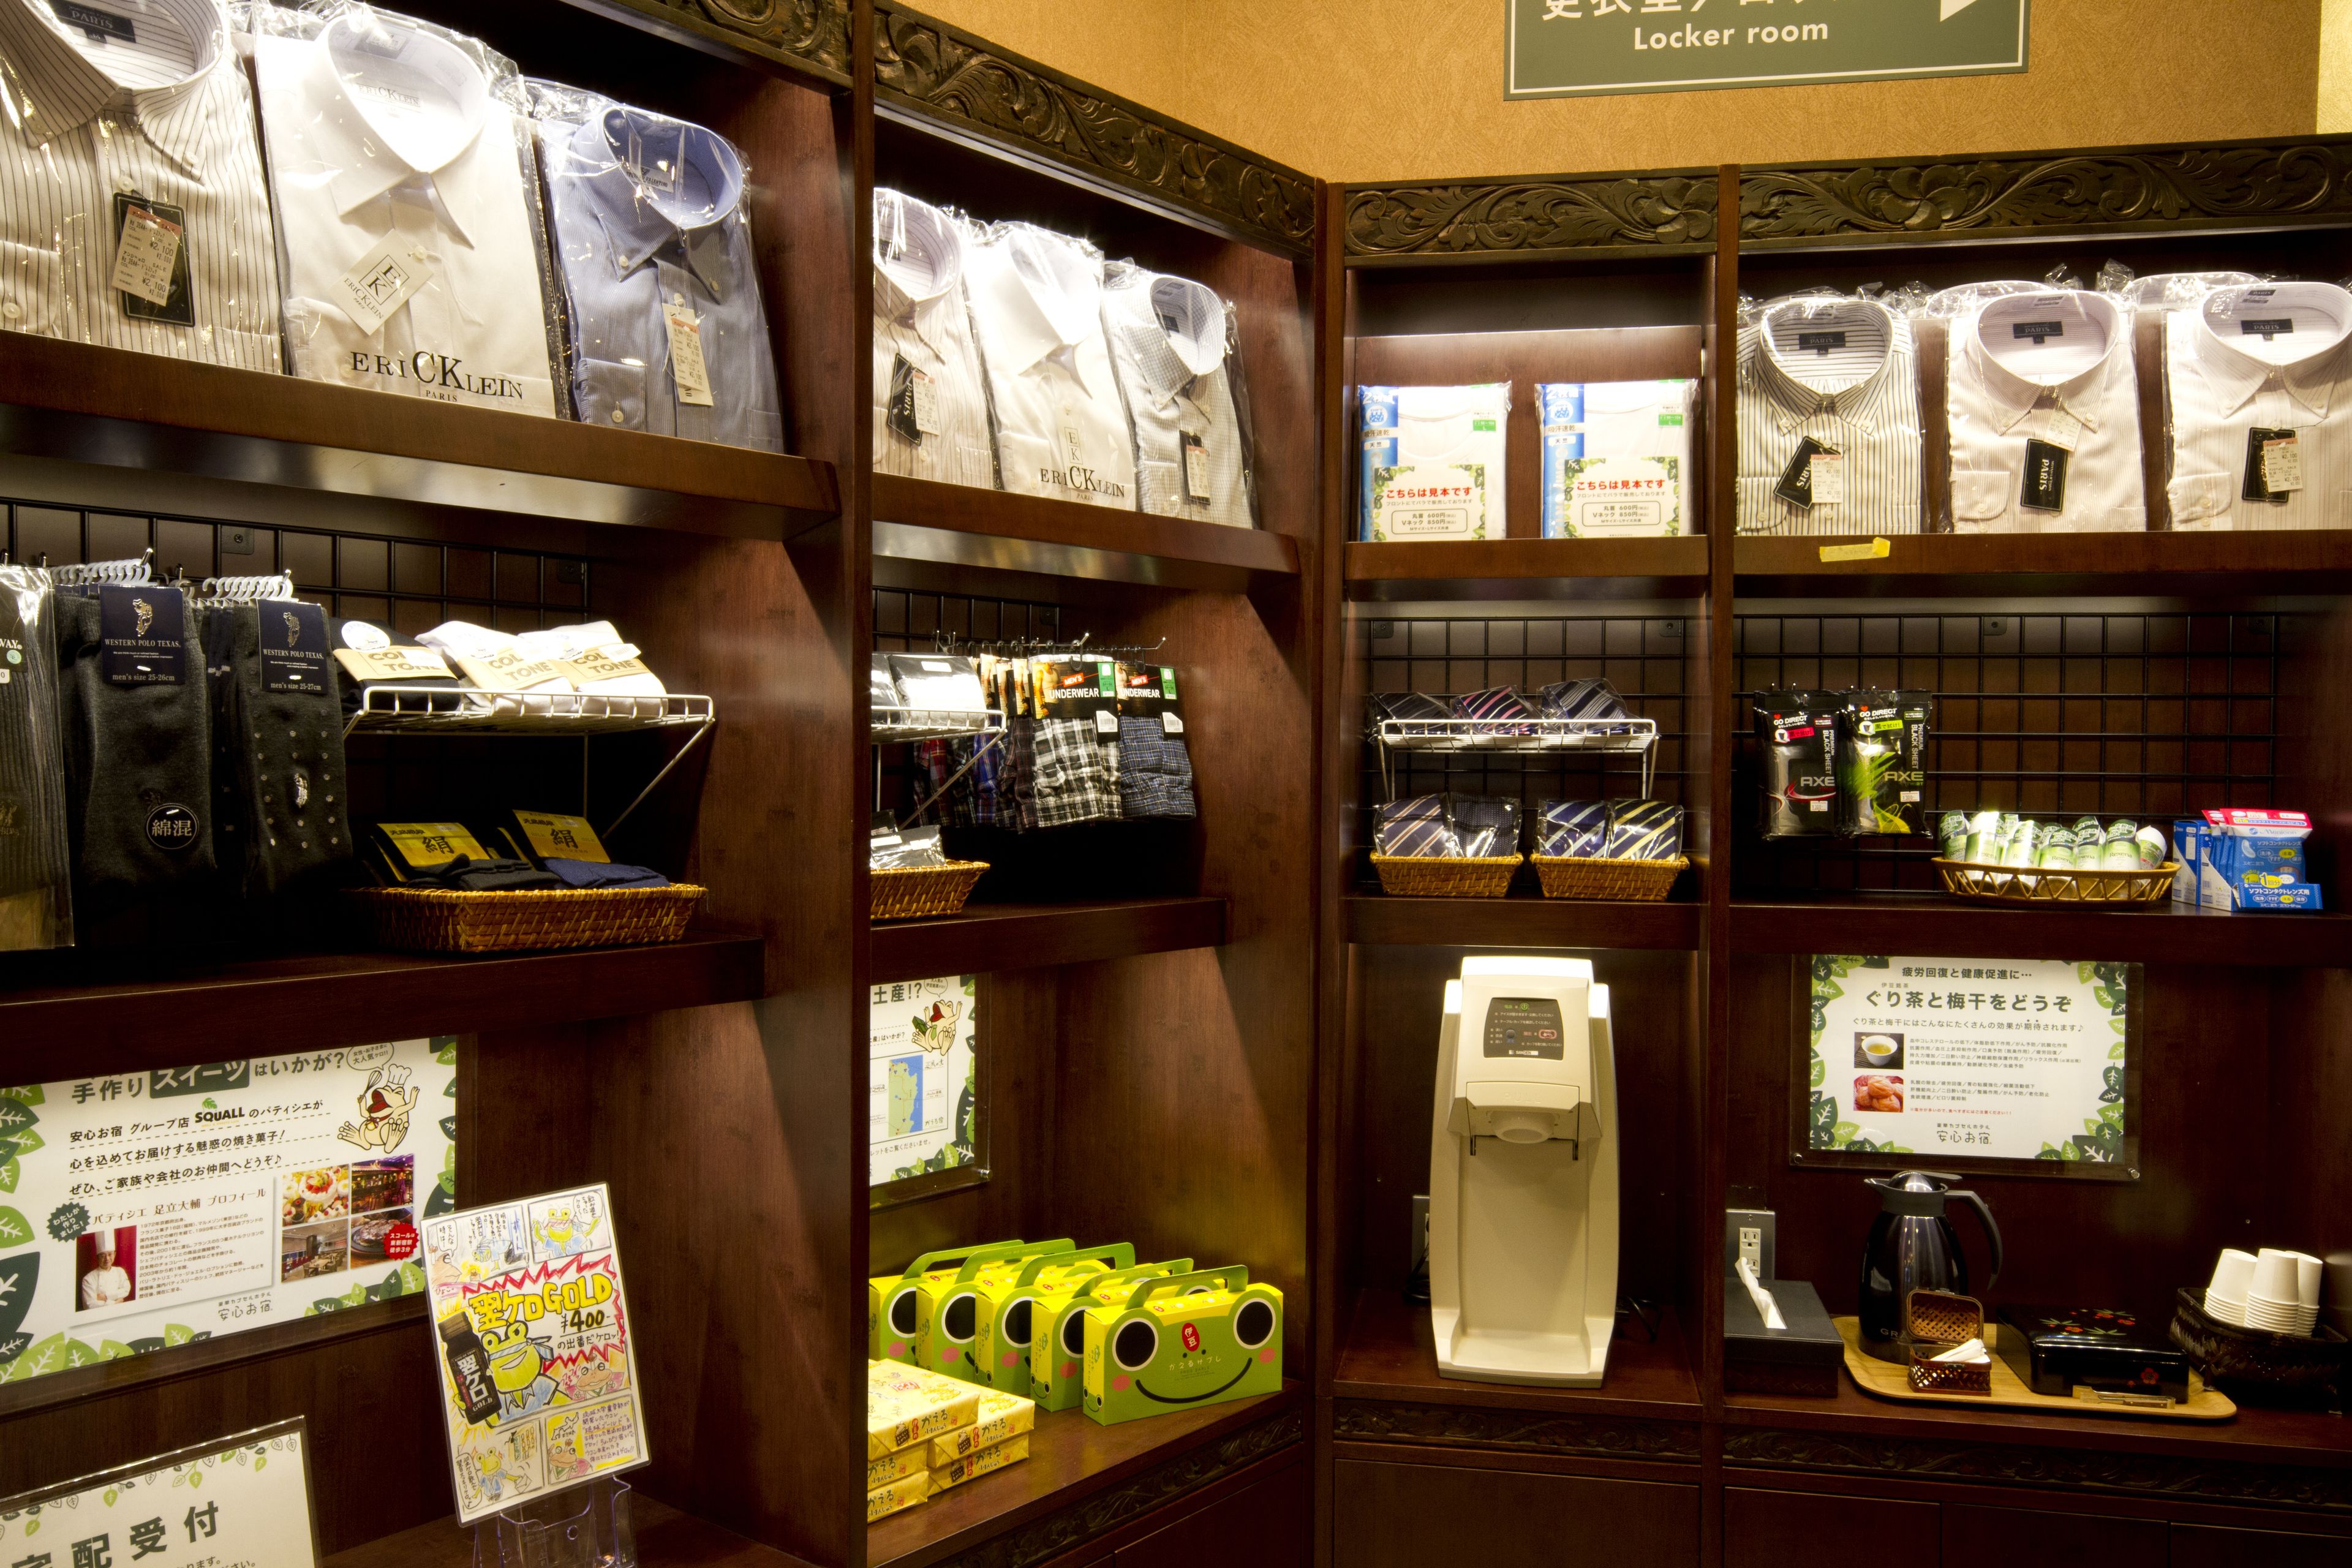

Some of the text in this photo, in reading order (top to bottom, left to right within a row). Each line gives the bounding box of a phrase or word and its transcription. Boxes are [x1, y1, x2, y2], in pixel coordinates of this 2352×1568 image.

[72, 10, 113, 29] PARIS
[1634, 23, 1828, 50] Locker room
[366, 275, 388, 298] K
[344, 277, 384, 320] ERICKLEIN
[426, 390, 458, 402] PARIS
[903, 381, 913, 417] PARIS
[1796, 461, 1811, 488] ARIS
[2039, 459, 2050, 491] PARIS
[1386, 487, 1472, 499] こちらは見本です
[1577, 479, 1665, 491] こちらは見本です
[505, 662, 552, 680] TONE
[588, 660, 637, 674] TONE
[1065, 675, 1083, 685] MEN'S
[1131, 676, 1147, 685] MEN'S
[1049, 688, 1100, 699] UNDERWEAR
[1120, 687, 1161, 698] UNDERWEAR
[1785, 715, 1807, 724] DIRECT
[1872, 708, 1898, 717] DIRECT
[1800, 777, 1836, 787] AXE
[1884, 771, 1924, 782] AXE
[152, 820, 192, 837] 綿混
[421, 835, 454, 854] 絹
[549, 828, 579, 849] 絹
[1902, 967, 2032, 980] 疲労回復と健康促進に…
[1866, 990, 2071, 1013] ぐり茶と梅干をどうぞ
[72, 1051, 344, 1104] 手作り スイーツ はいかが?
[70, 1126, 123, 1144] 安心お宿
[130, 1117, 190, 1135] グループ店
[195, 1107, 245, 1124] SQUALL
[249, 1099, 323, 1118] のパティシエが
[1937, 1130, 1990, 1145] 安心お宿
[70, 1130, 285, 1170] 心を込めてお届けする魅惑の焼き菓子!
[92, 1188, 266, 1225] パティシエ 足立大輔 プロフィール
[52, 1207, 80, 1226] わたしが
[62, 1216, 77, 1229] 作り
[59, 1221, 85, 1238] ました!
[218, 1299, 272, 1322] 安心お宿
[1184, 1326, 1197, 1348] 伊豆
[1169, 1355, 1222, 1371] かえるサブレ
[456, 1354, 489, 1404] 翌ケロ
[472, 1397, 493, 1412] GOLD
[921, 1408, 948, 1428] かえる
[982, 1417, 1006, 1438] かえる
[975, 1444, 1001, 1466] かえる
